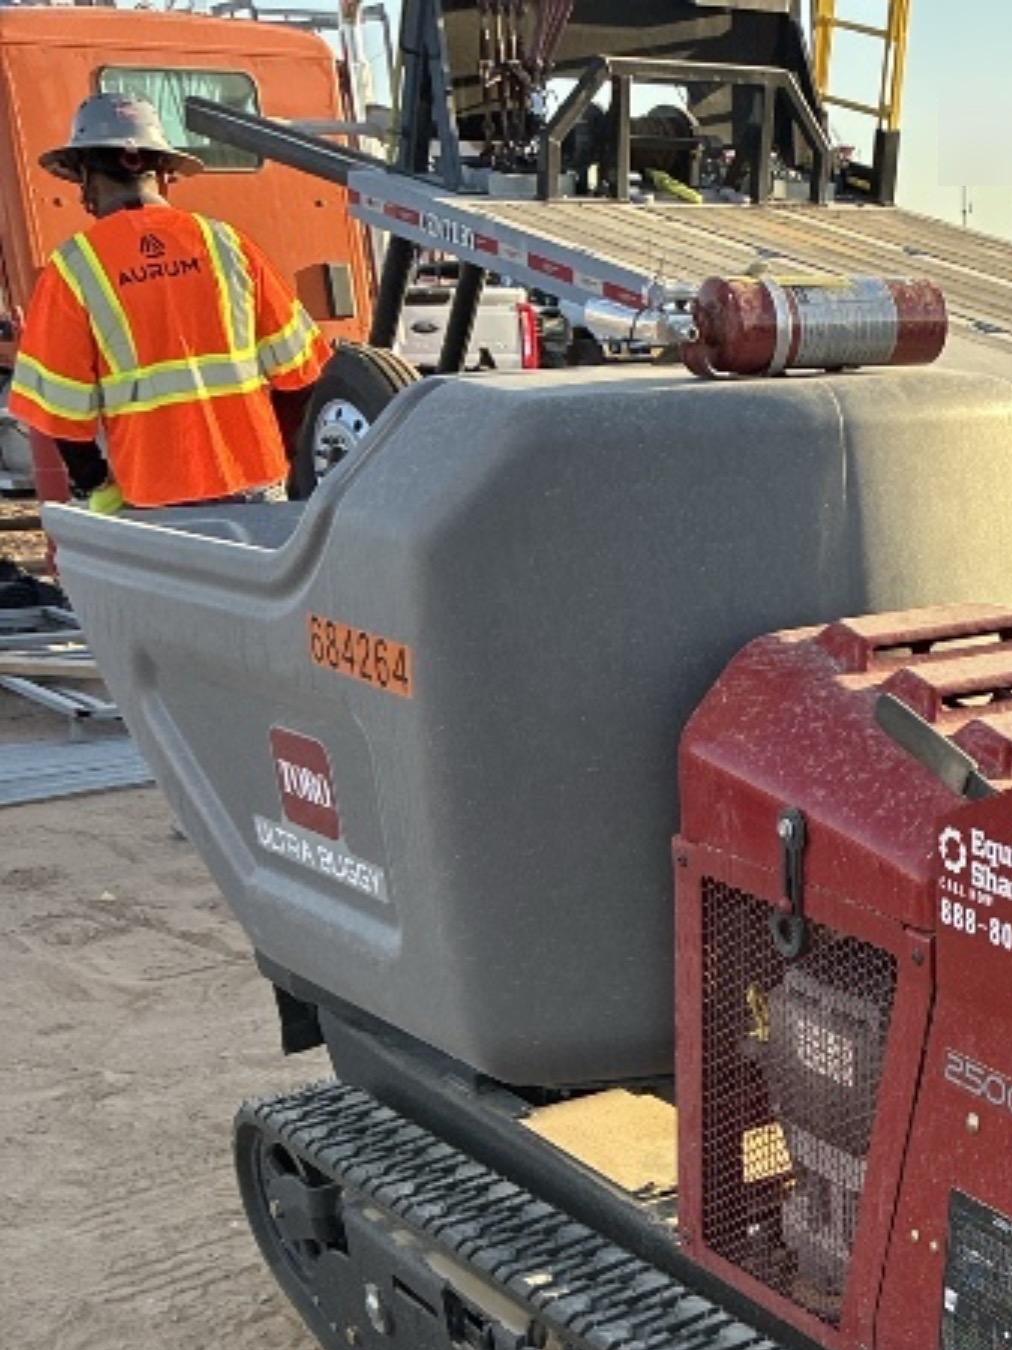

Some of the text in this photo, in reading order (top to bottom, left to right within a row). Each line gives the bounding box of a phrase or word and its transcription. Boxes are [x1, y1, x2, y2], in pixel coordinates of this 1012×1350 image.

[119, 257, 201, 286] AURUM
[310, 615, 409, 688] 684264
[277, 758, 332, 808] TORO
[254, 818, 316, 868] ULTRA
